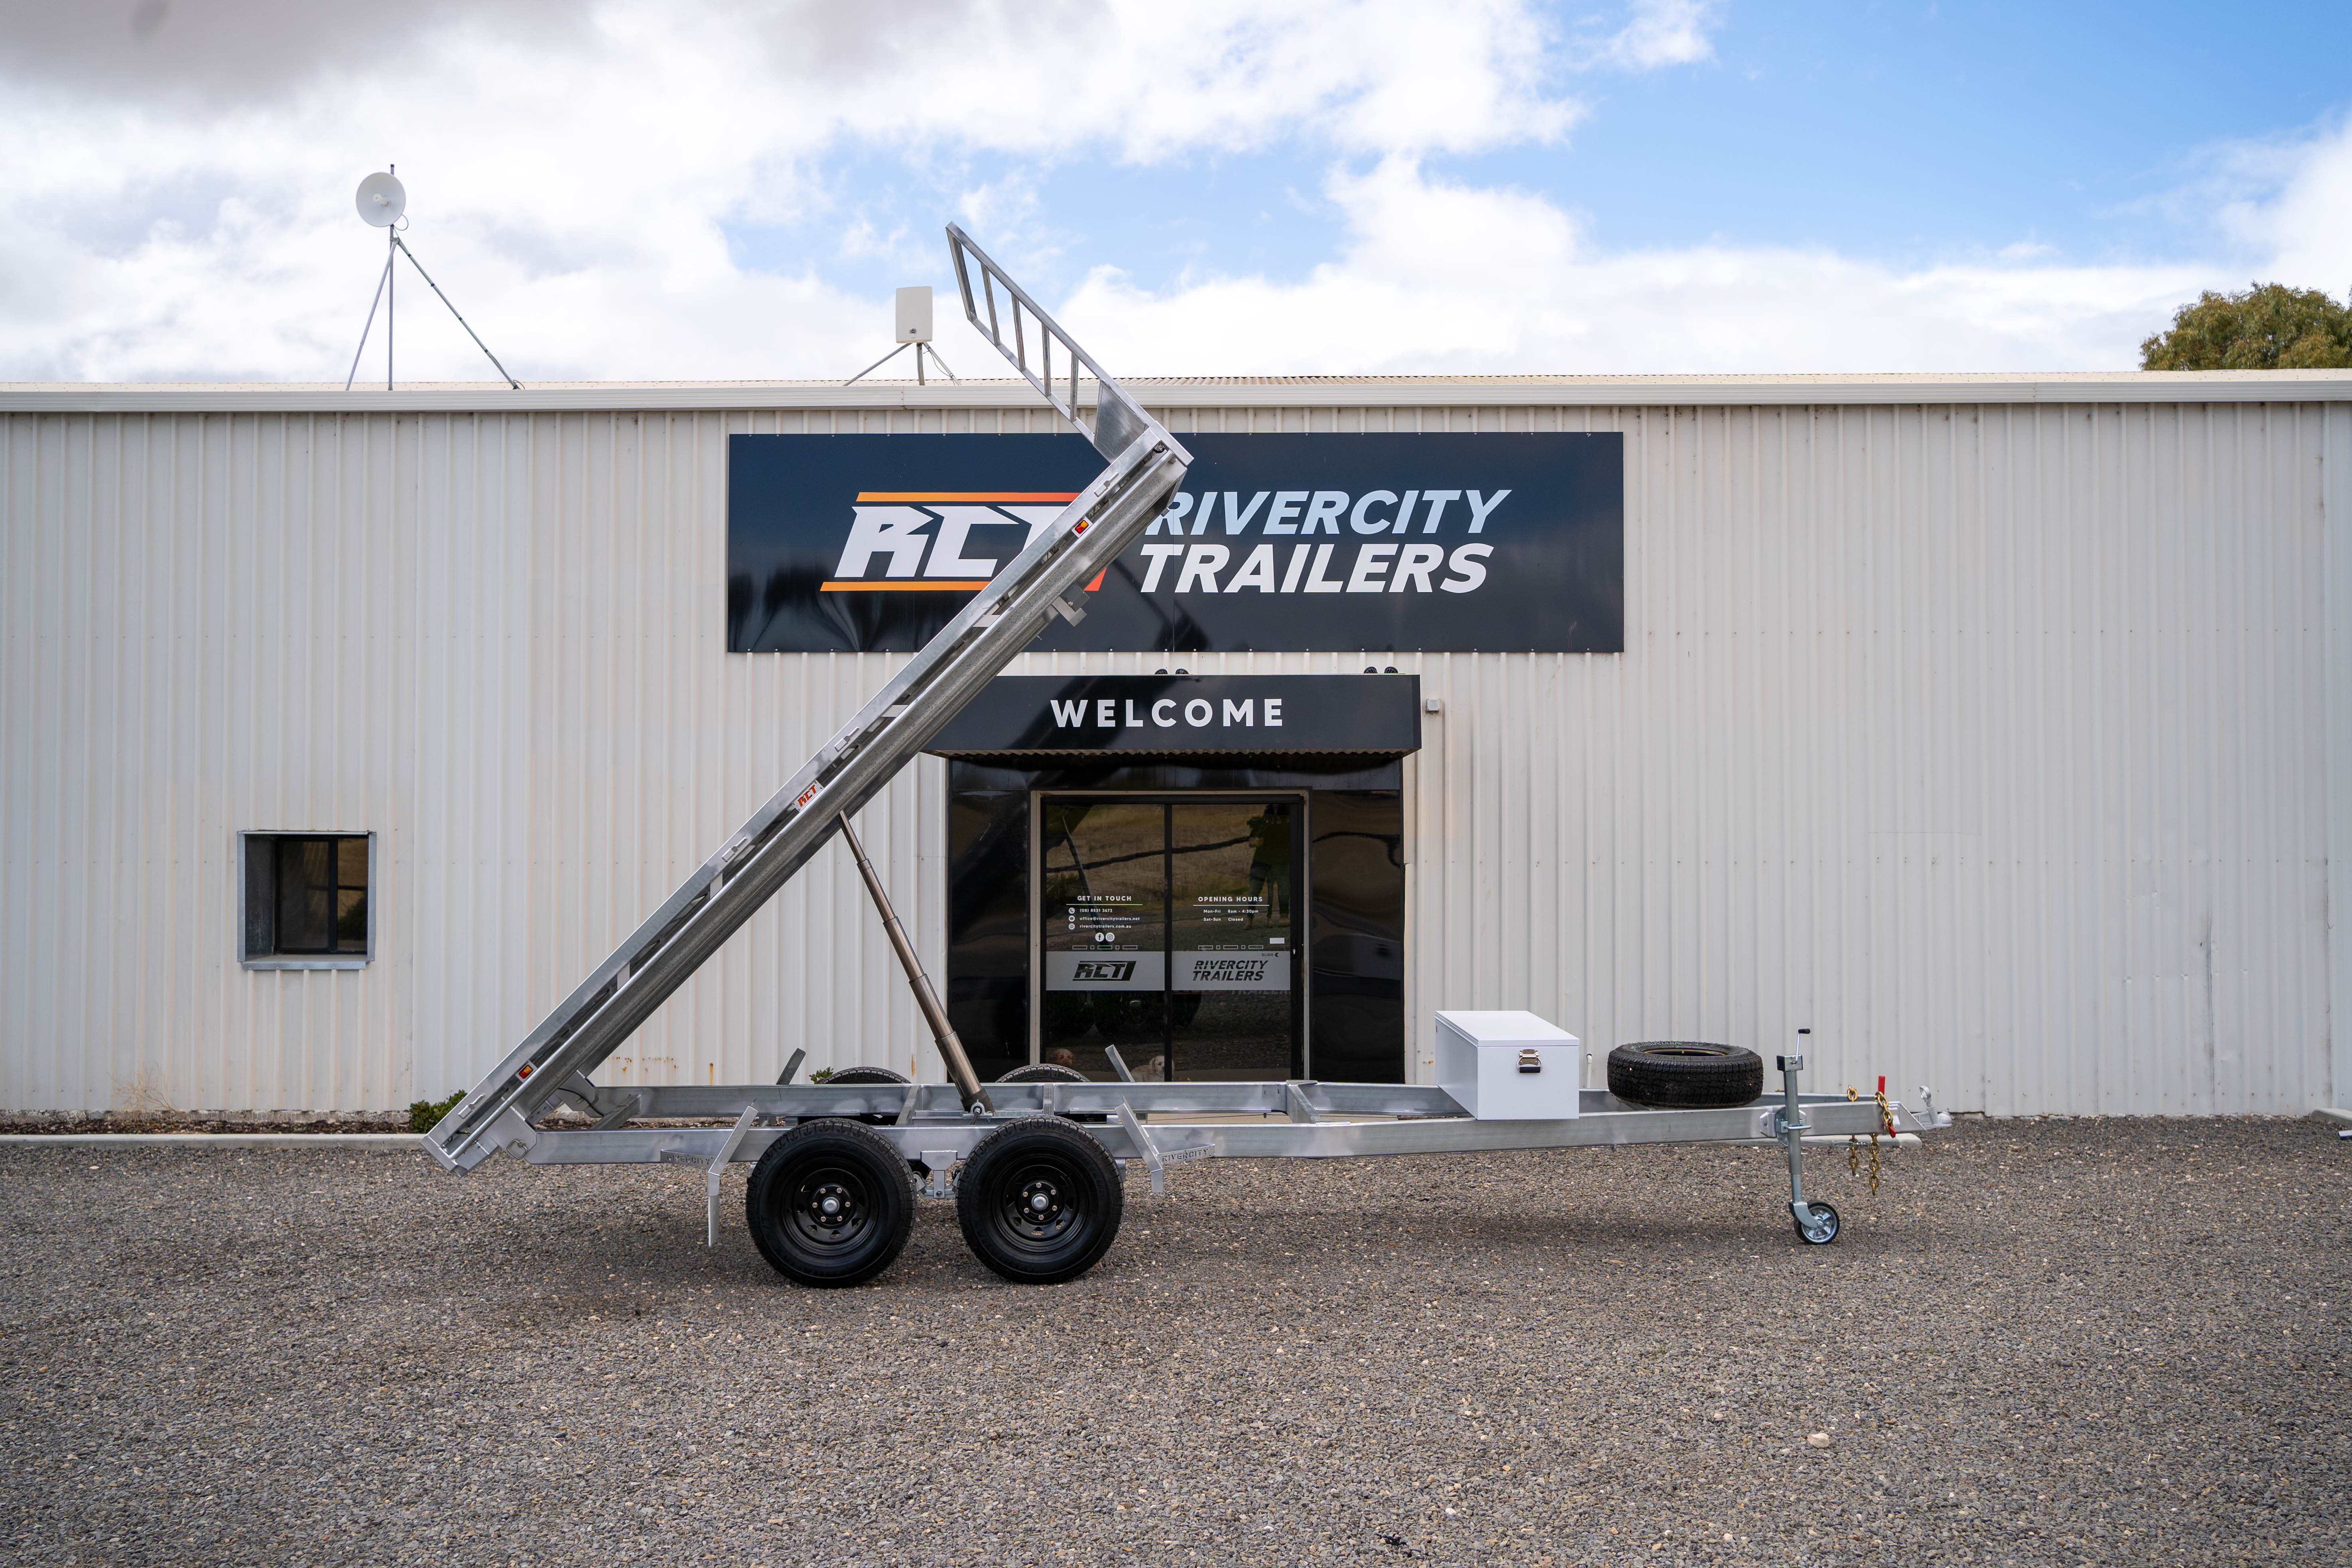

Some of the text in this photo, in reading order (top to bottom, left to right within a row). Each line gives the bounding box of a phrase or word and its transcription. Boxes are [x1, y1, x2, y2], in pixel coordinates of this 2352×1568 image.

[1145, 490, 1512, 535] RIVERCITY
[1140, 543, 1495, 593] TRAILERS
[1050, 699, 1282, 727] WELCOME
[798, 784, 816, 807] RCT
[1194, 960, 1269, 970] RIVERCITY
[1193, 970, 1265, 981] TRAILERS
[667, 1154, 710, 1165] RIVERCITY
[1162, 1148, 1208, 1162] RIVERCITY
